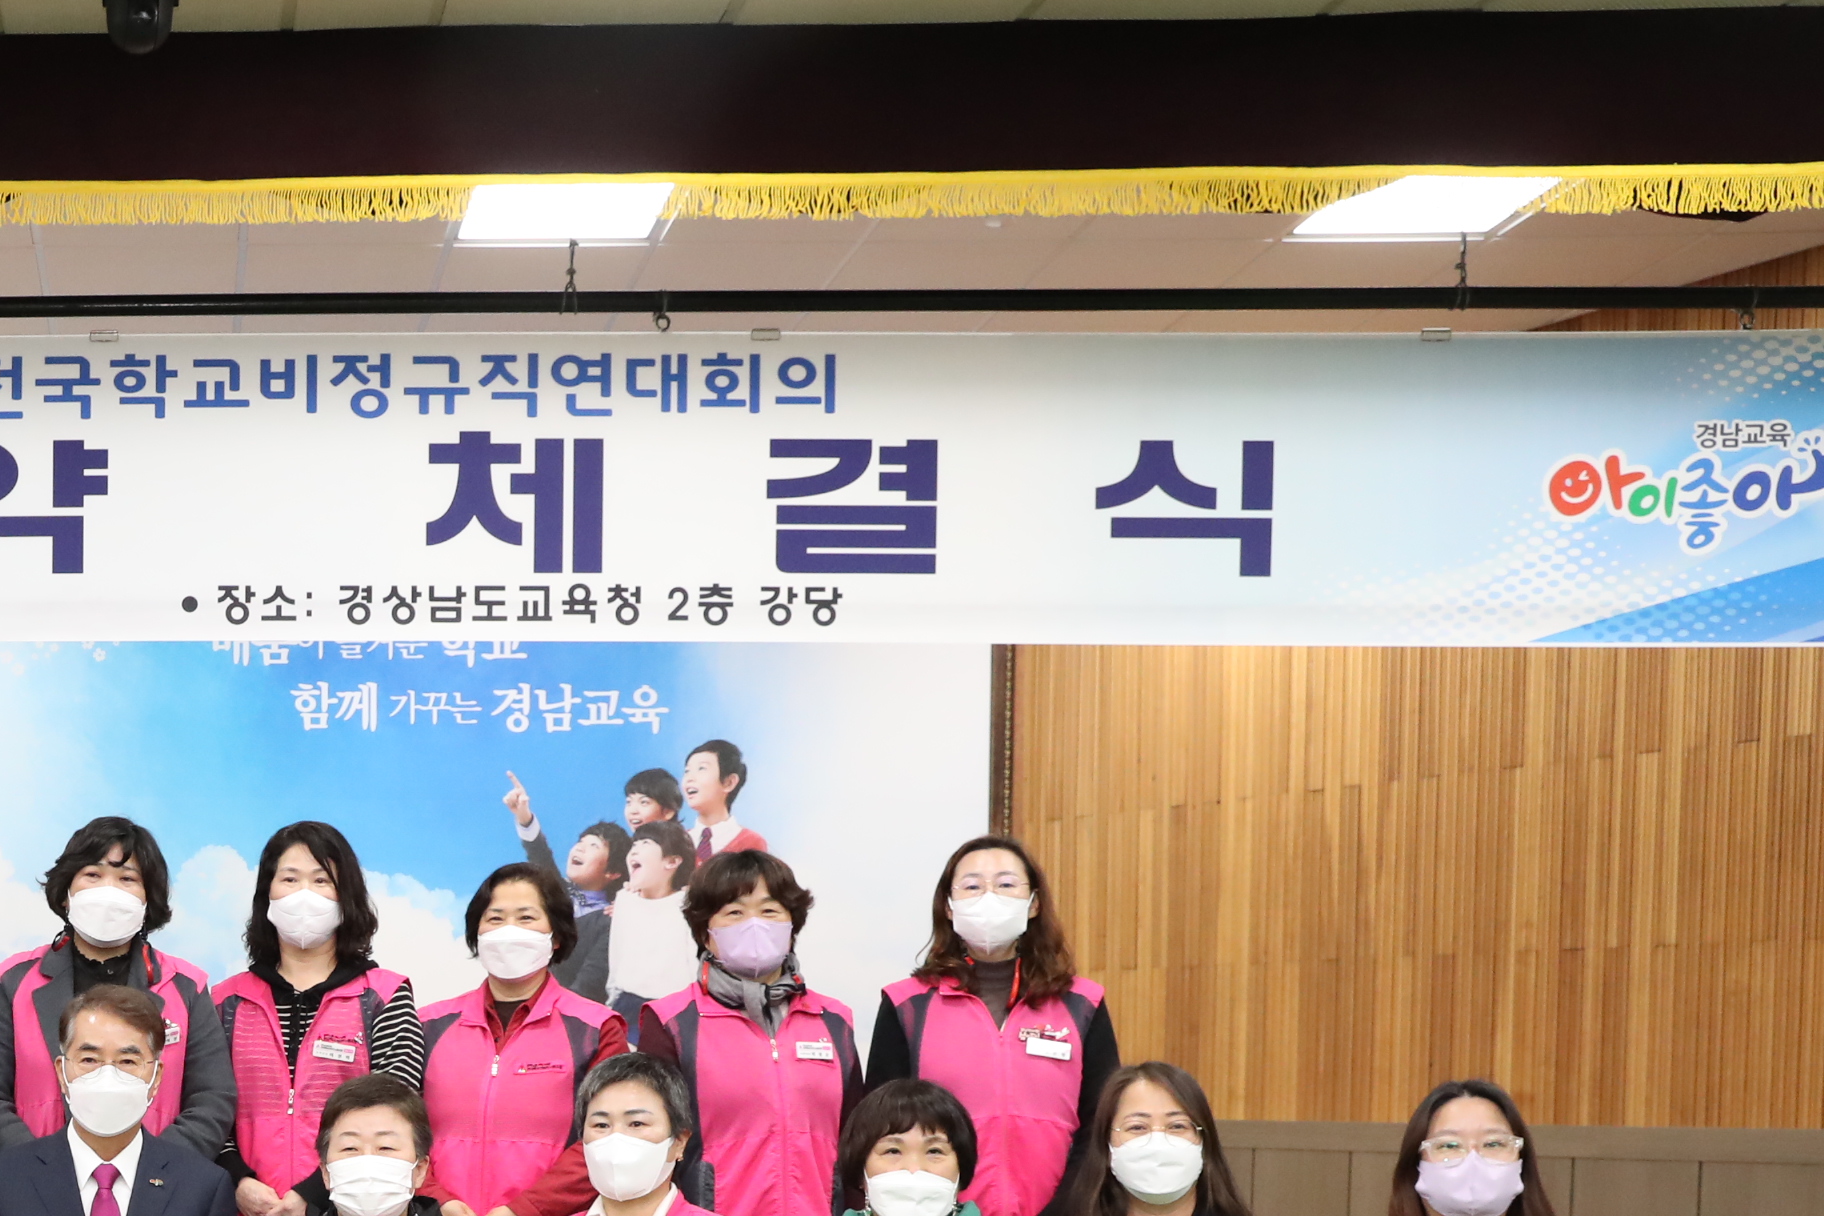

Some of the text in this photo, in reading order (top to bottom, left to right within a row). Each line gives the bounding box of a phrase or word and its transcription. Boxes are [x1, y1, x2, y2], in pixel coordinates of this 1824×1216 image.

[1695, 421, 1792, 448] 경남교육
[426, 430, 604, 574] 체
[766, 438, 938, 574] 결
[1095, 440, 1274, 577] 식
[1549, 448, 1824, 550] 아이좋아
[217, 583, 844, 627] 장소: 경상남도교육청 2층 강당
[289, 681, 670, 734] 함께 가꾸는 경남교육
